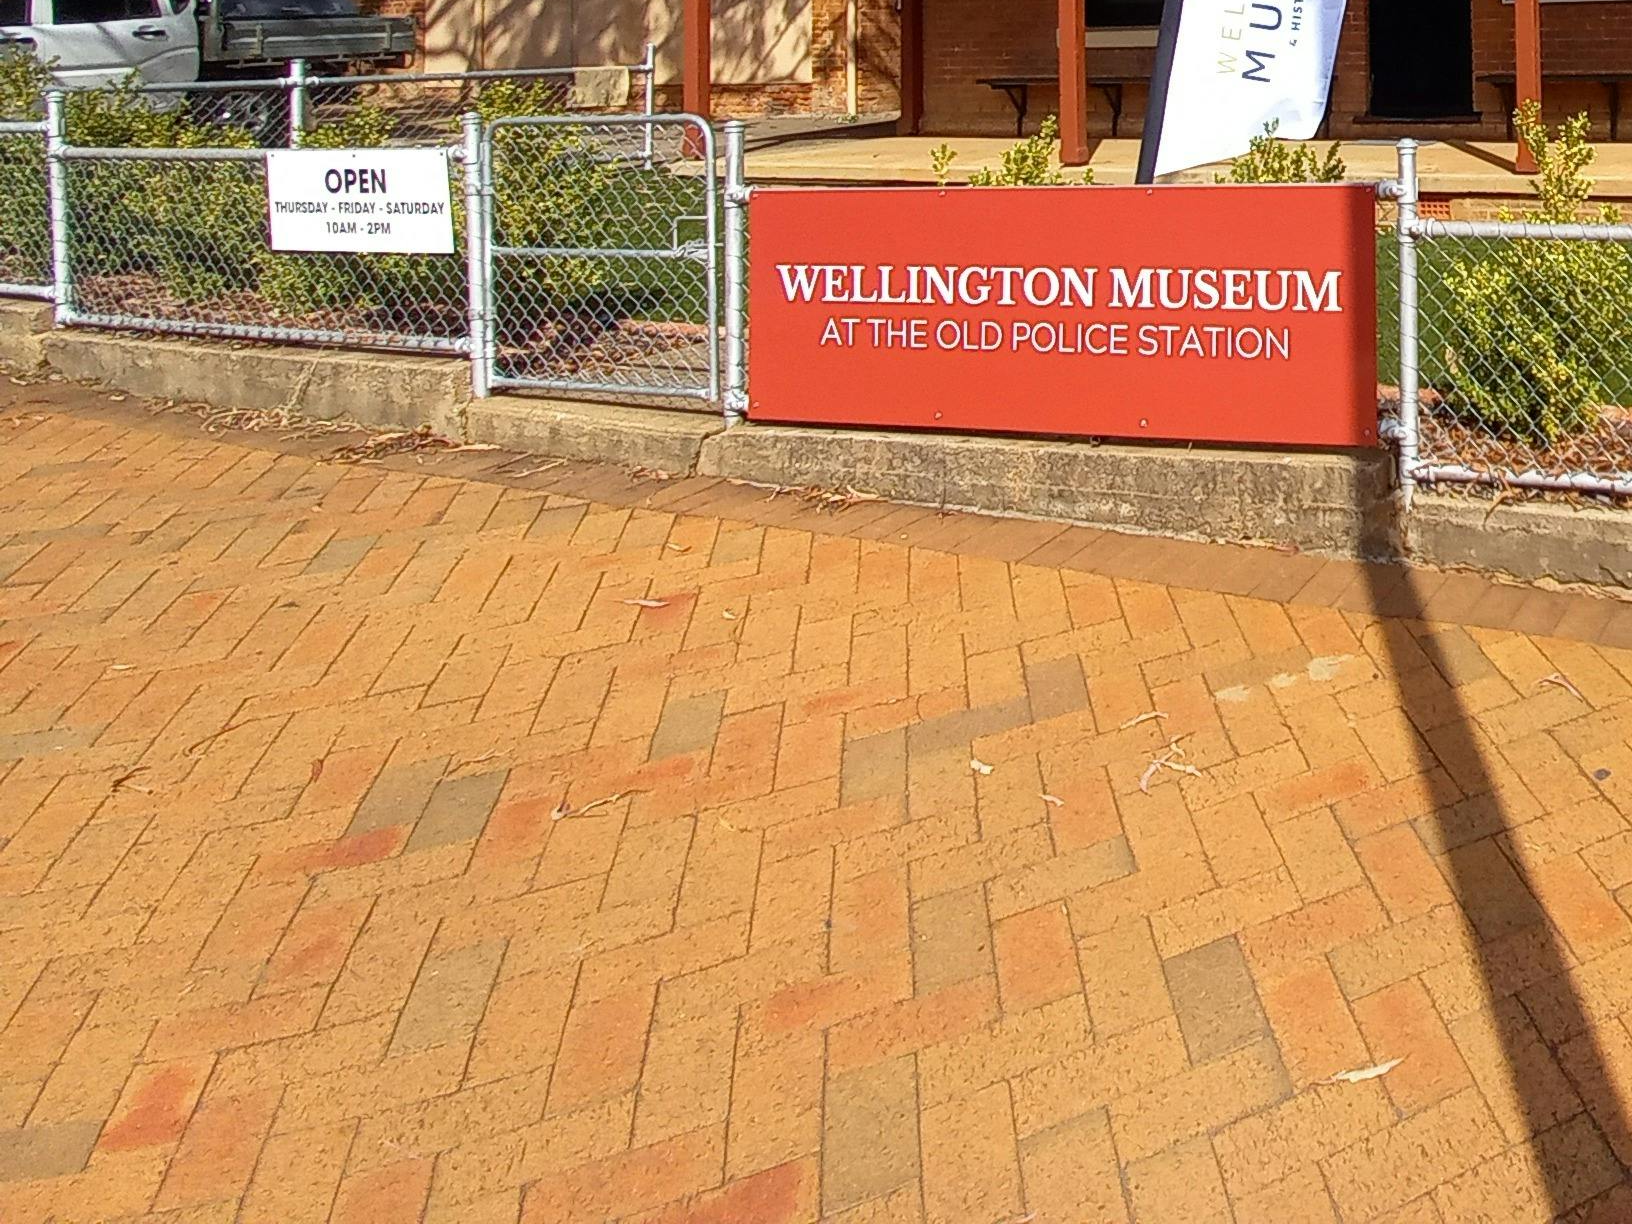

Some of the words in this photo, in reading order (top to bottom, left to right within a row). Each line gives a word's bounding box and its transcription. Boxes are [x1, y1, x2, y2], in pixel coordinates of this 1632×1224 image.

[324, 168, 387, 194] OPEN
[275, 201, 329, 214] THURSDAY
[338, 201, 376, 214] FRIDAY
[386, 201, 445, 215] SATURDAY
[326, 221, 357, 234] 10AM
[367, 222, 391, 235] 2PM
[776, 264, 1099, 307] WELLINGTON
[1108, 267, 1343, 312] MUSEUM
[820, 317, 861, 347] AT
[866, 318, 928, 348] THE
[936, 320, 1002, 350] OLD
[1012, 322, 1129, 353] POLICE
[1138, 325, 1290, 359] STATION
